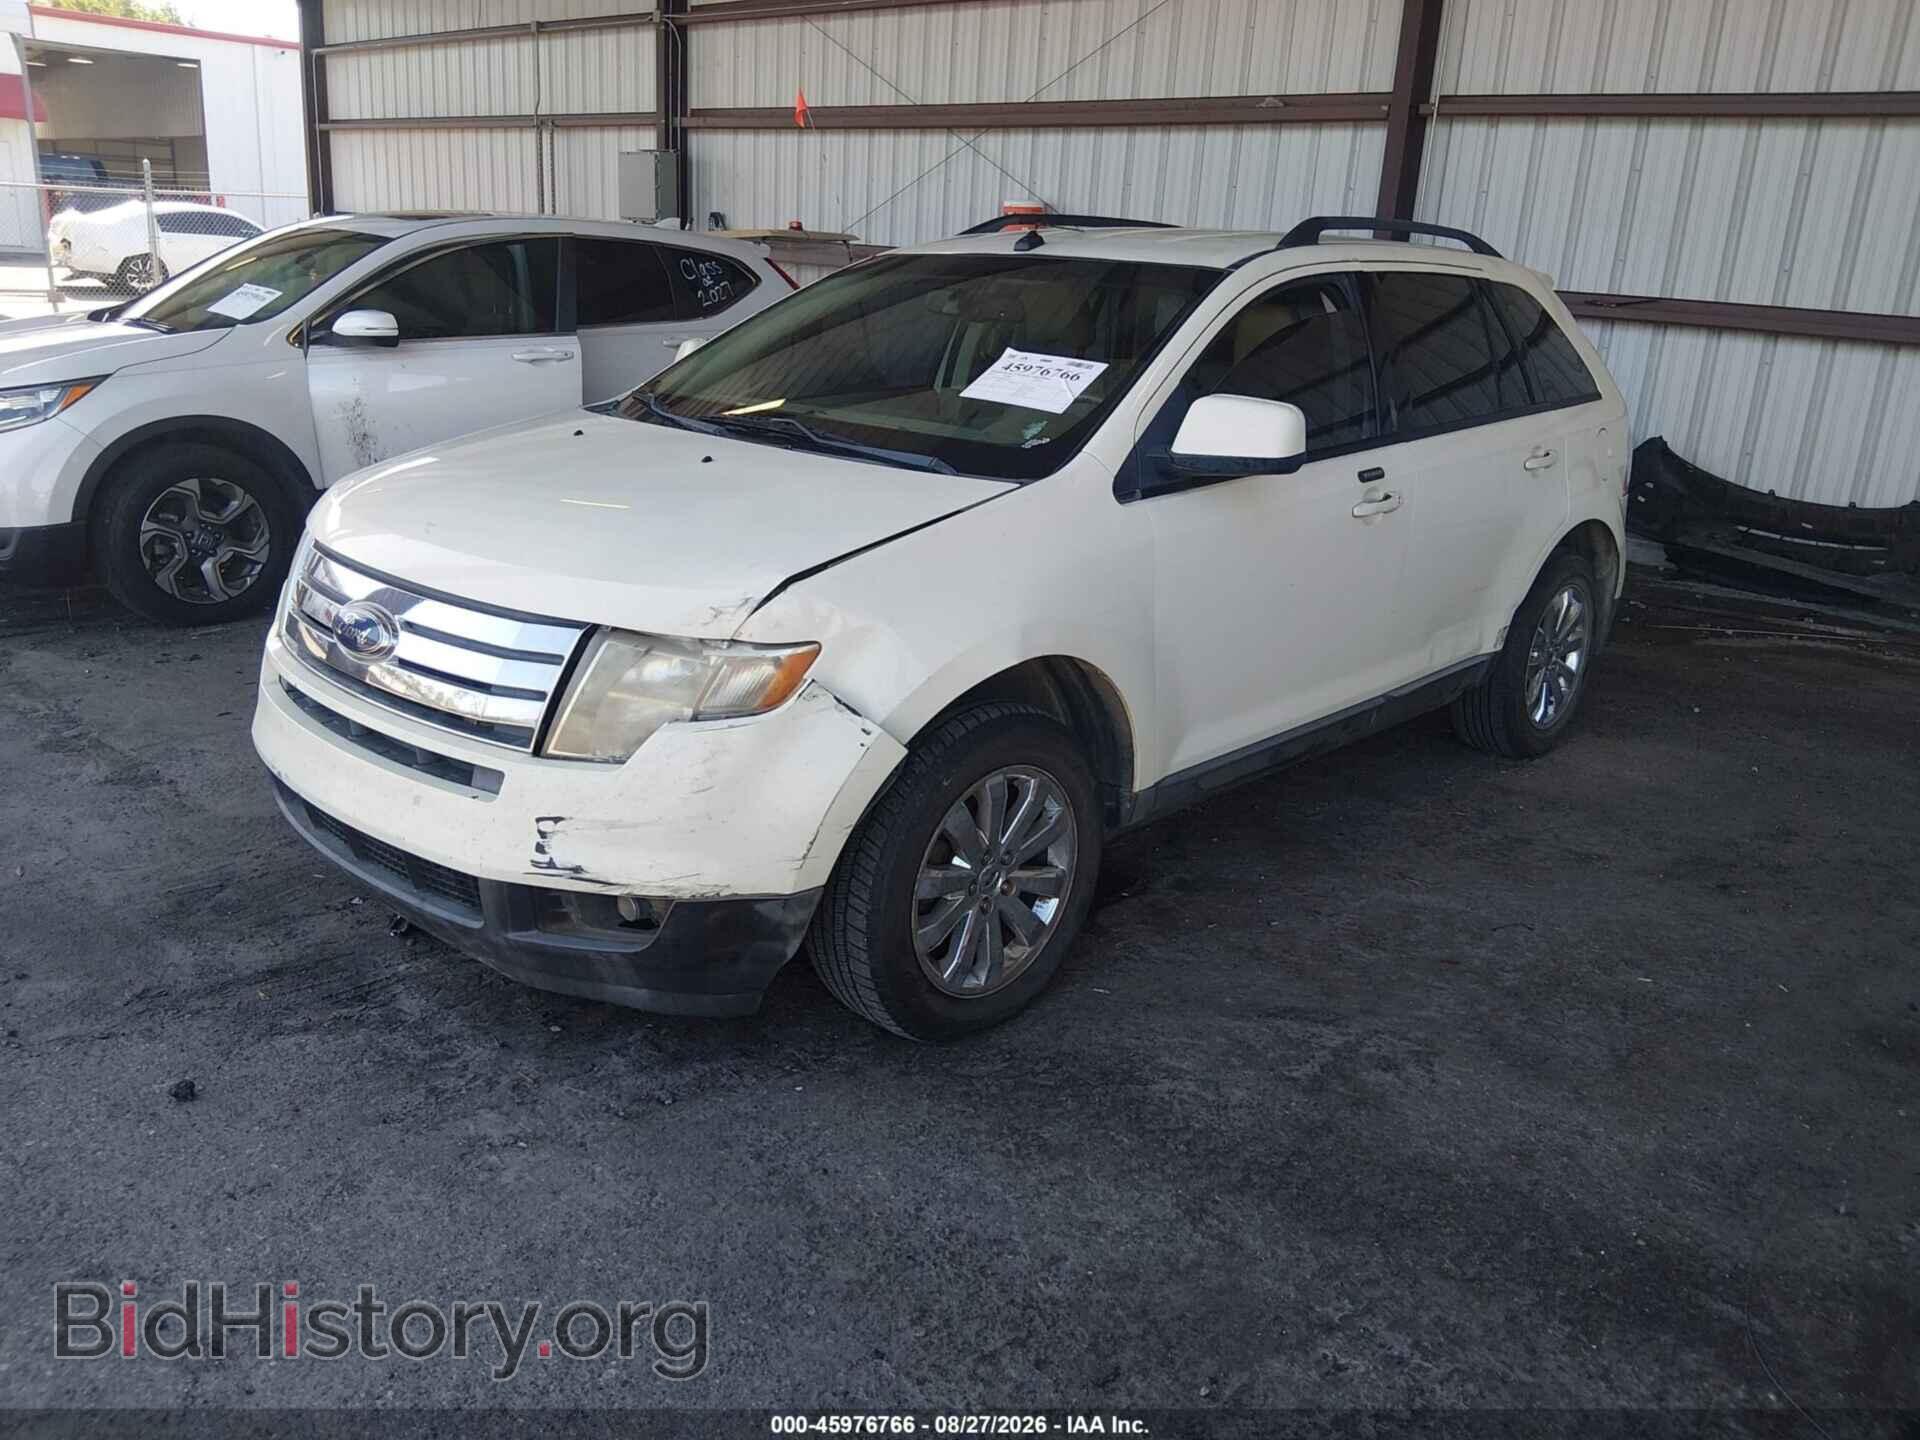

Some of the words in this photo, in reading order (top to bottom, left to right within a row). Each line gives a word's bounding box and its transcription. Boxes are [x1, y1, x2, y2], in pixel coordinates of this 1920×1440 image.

[680, 257, 722, 280] Class
[697, 281, 735, 306] 2027
[1001, 362, 1081, 382] 45976766
